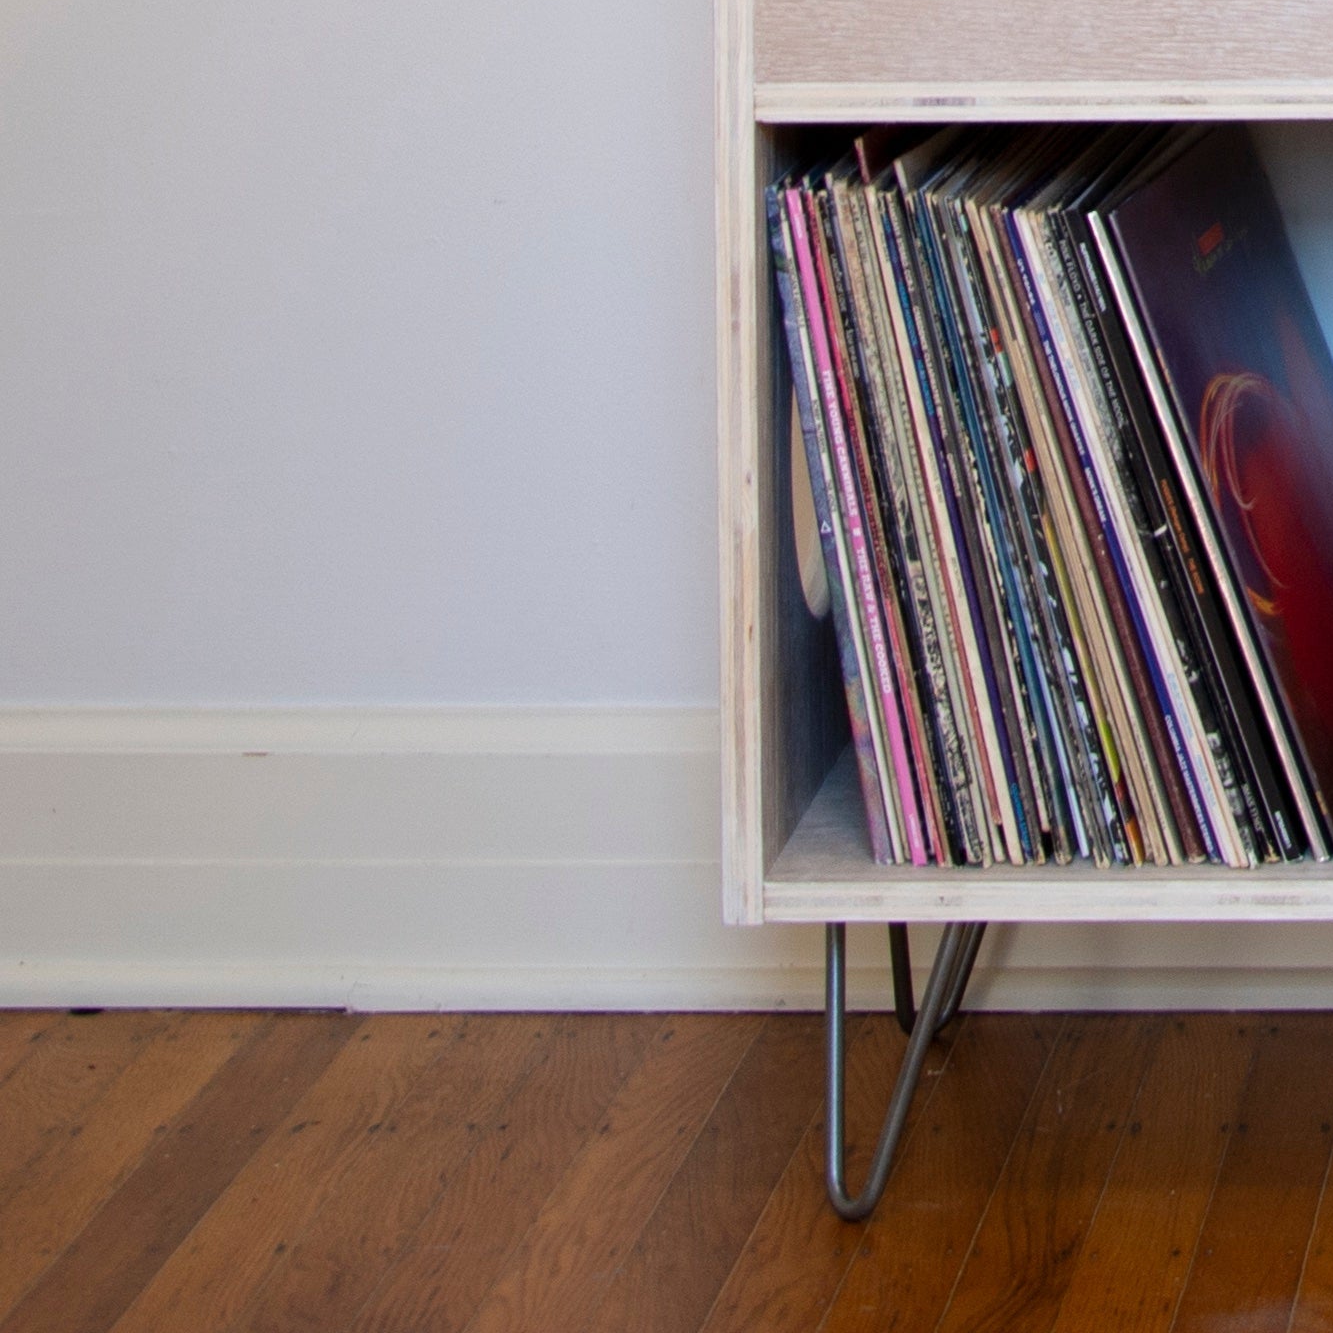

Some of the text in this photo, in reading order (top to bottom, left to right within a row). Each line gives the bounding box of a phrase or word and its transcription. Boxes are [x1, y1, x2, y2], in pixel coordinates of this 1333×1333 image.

[1058, 238, 1082, 292] PINK FLOYD
[835, 282, 843, 292] OF
[838, 293, 847, 312] LOVE
[1079, 301, 1091, 319] THE
[1084, 319, 1099, 345] DARK
[1093, 345, 1106, 365] SIDE
[1100, 366, 1110, 379] OF
[1042, 340, 1086, 455] THE THELONIOUS MONK QUARTET
[1104, 379, 1116, 397] THE
[1110, 398, 1124, 422] MOON
[821, 369, 858, 516] FINE YOUNG CANNIBALS
[1083, 466, 1106, 522] MONK'S DREAM
[855, 546, 869, 574] THE
[860, 574, 874, 603] RAW
[866, 603, 876, 614] &
[868, 616, 881, 638] THE
[873, 639, 892, 693] COOKED
[1163, 714, 1181, 752] COLUMBIA
[1176, 752, 1187, 770] JAZZ
